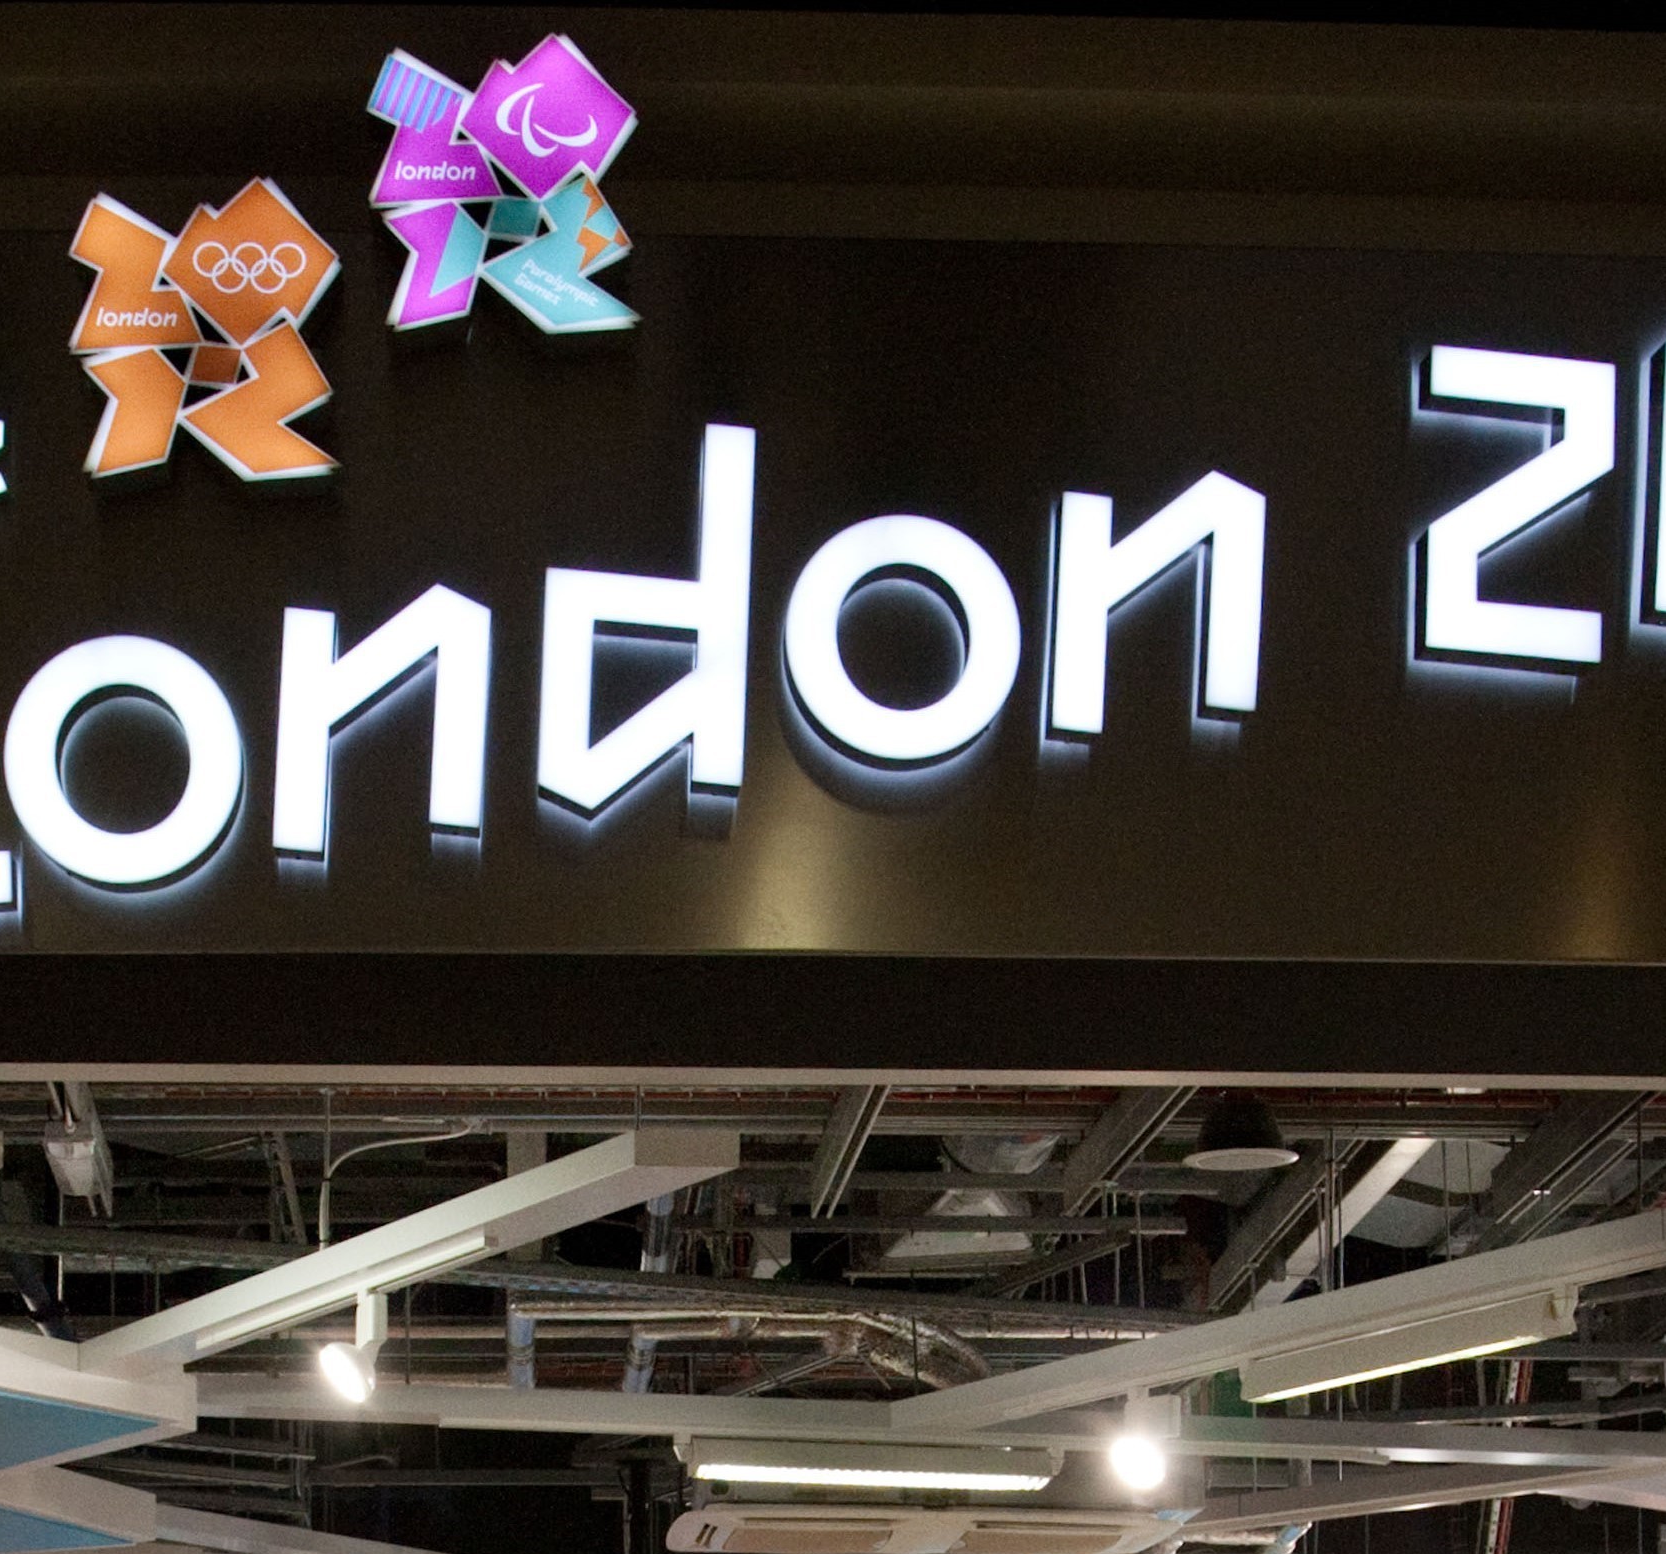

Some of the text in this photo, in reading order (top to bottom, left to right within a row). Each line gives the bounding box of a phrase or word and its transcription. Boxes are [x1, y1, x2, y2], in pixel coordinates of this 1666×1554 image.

[394, 160, 477, 182] london
[513, 272, 562, 306] Games
[521, 257, 600, 308] Paralympic
[95, 306, 178, 328] london
